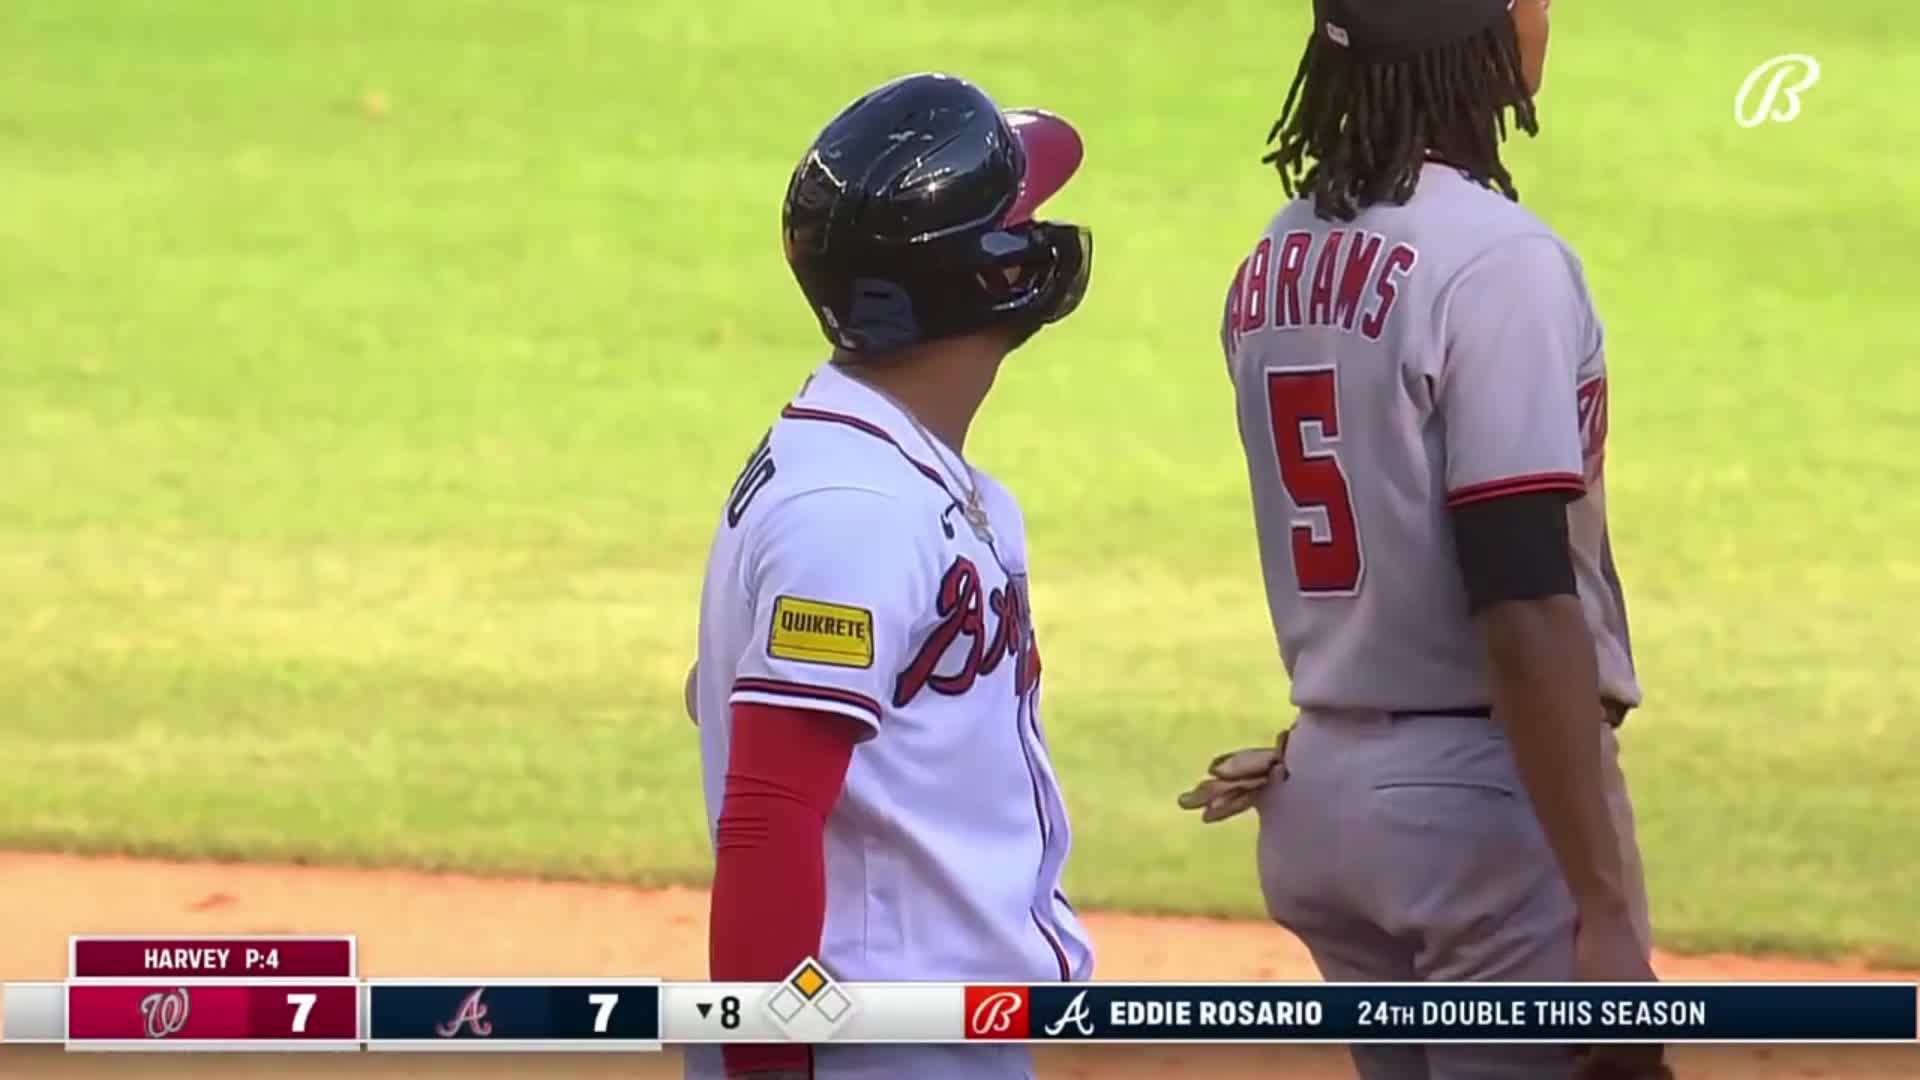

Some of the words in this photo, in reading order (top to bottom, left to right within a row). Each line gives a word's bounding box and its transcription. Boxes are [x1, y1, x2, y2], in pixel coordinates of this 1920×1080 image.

[1230, 229, 1418, 355] ABRAMS
[1265, 366, 1365, 597] 5
[781, 610, 866, 640] QUIKRETE
